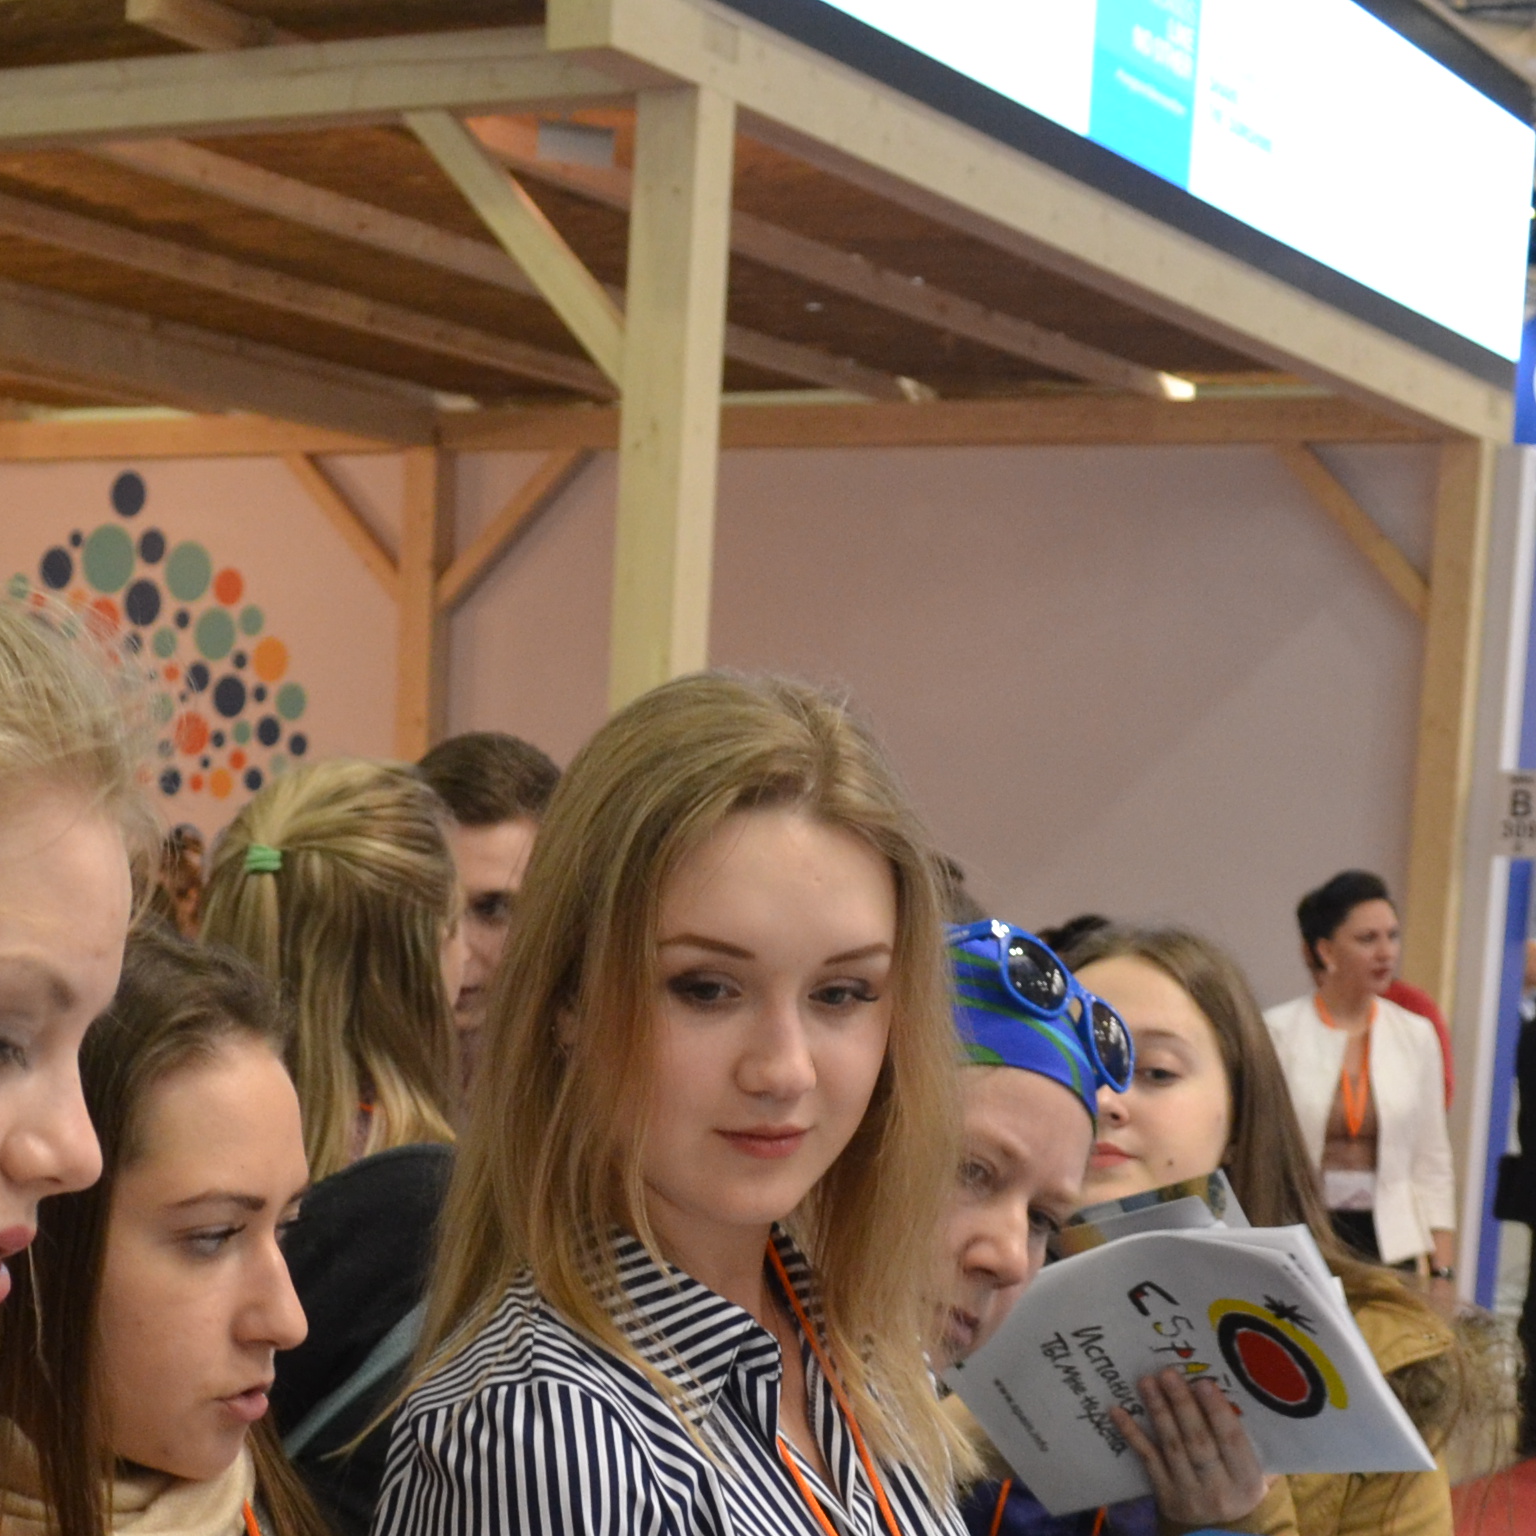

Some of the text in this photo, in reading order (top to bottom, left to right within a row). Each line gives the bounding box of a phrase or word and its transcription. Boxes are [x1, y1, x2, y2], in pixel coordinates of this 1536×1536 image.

[1511, 789, 1531, 816] B
[1071, 1325, 1145, 1417] Испания
[1076, 1394, 1127, 1457] нужна
